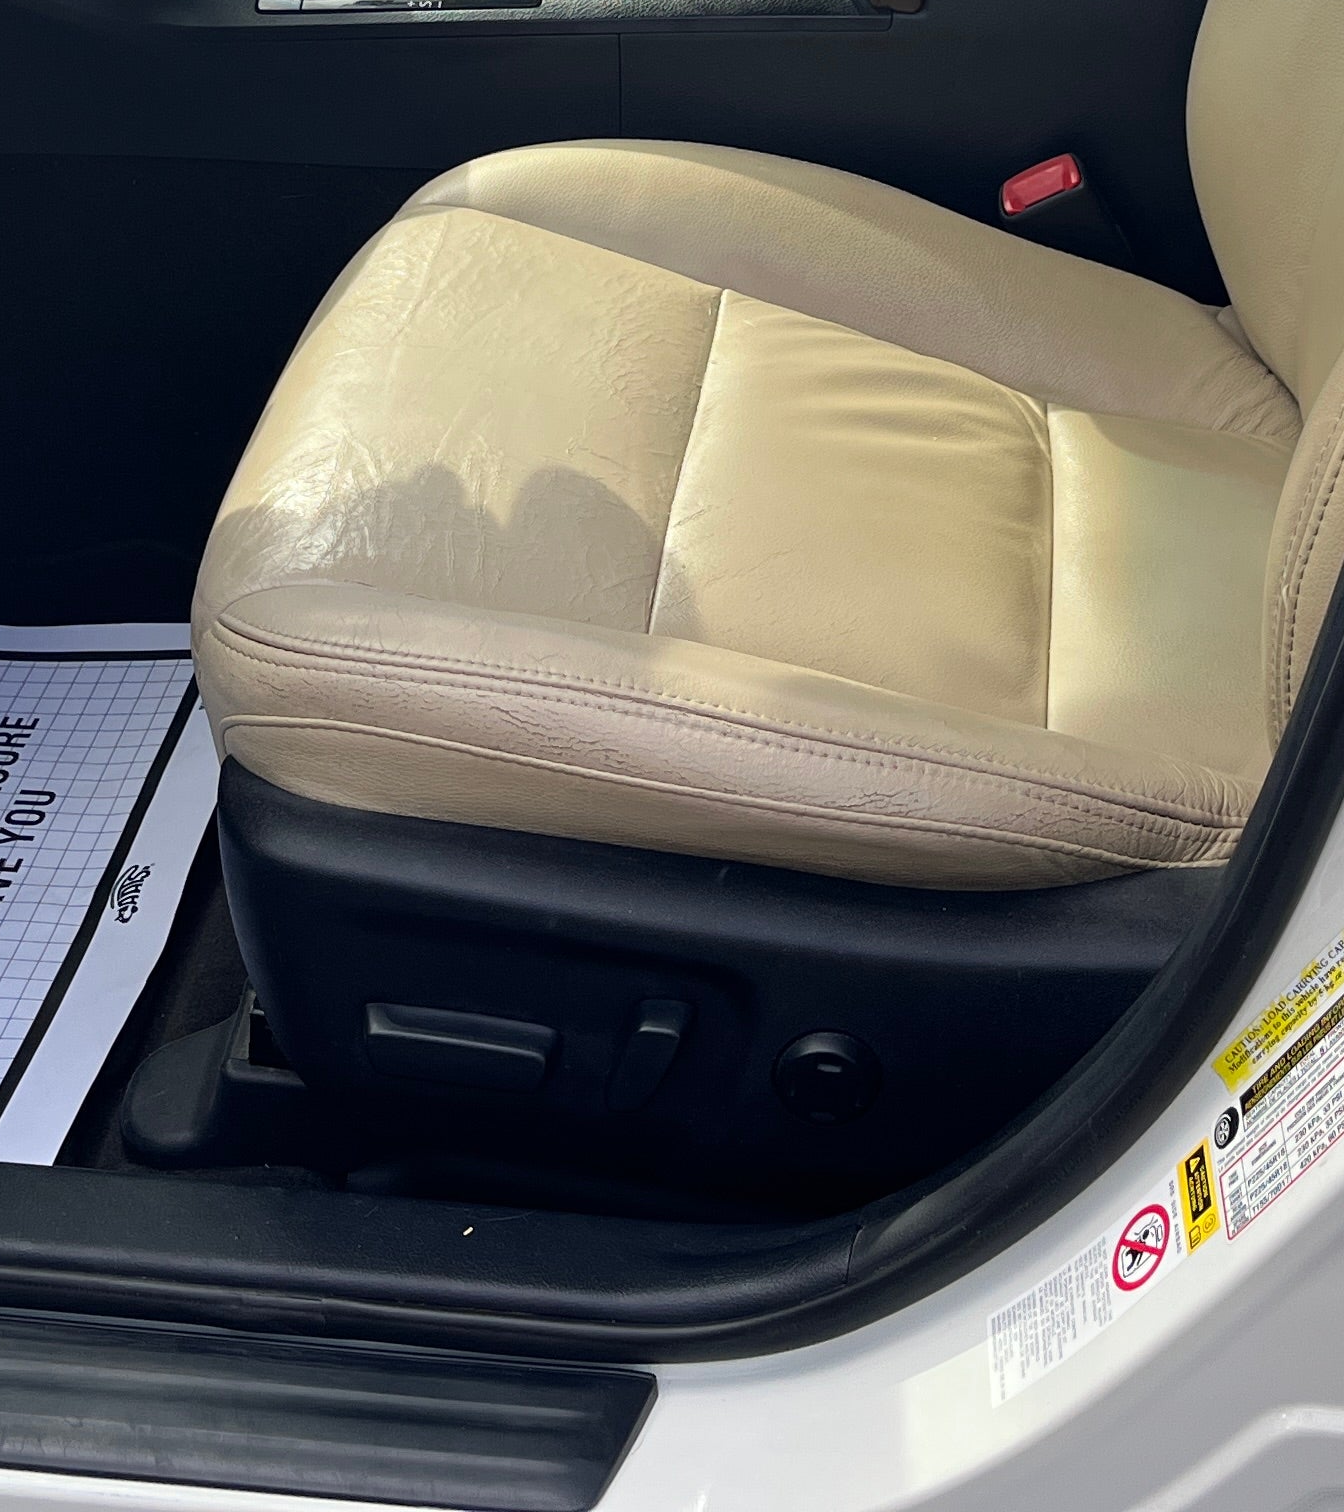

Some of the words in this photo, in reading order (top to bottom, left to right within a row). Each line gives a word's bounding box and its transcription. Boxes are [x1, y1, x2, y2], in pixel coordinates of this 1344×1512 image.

[1262, 1000, 1287, 1026] LOAD
[1286, 959, 1329, 1002] CARRYING
[1228, 1030, 1273, 1072] Modifications
[1272, 1021, 1282, 1030] to
[1281, 1007, 1296, 1022] this
[1295, 983, 1319, 1007] vehicle
[1252, 1034, 1281, 1065] carrying
[1280, 1006, 1308, 1036] capacity
[1252, 1073, 1268, 1094] TIRE
[1269, 1055, 1285, 1077] AND
[1287, 1021, 1319, 1059] LOADING
[1331, 1089, 1343, 1106] PSI
[1334, 1103, 1344, 1120] PSI
